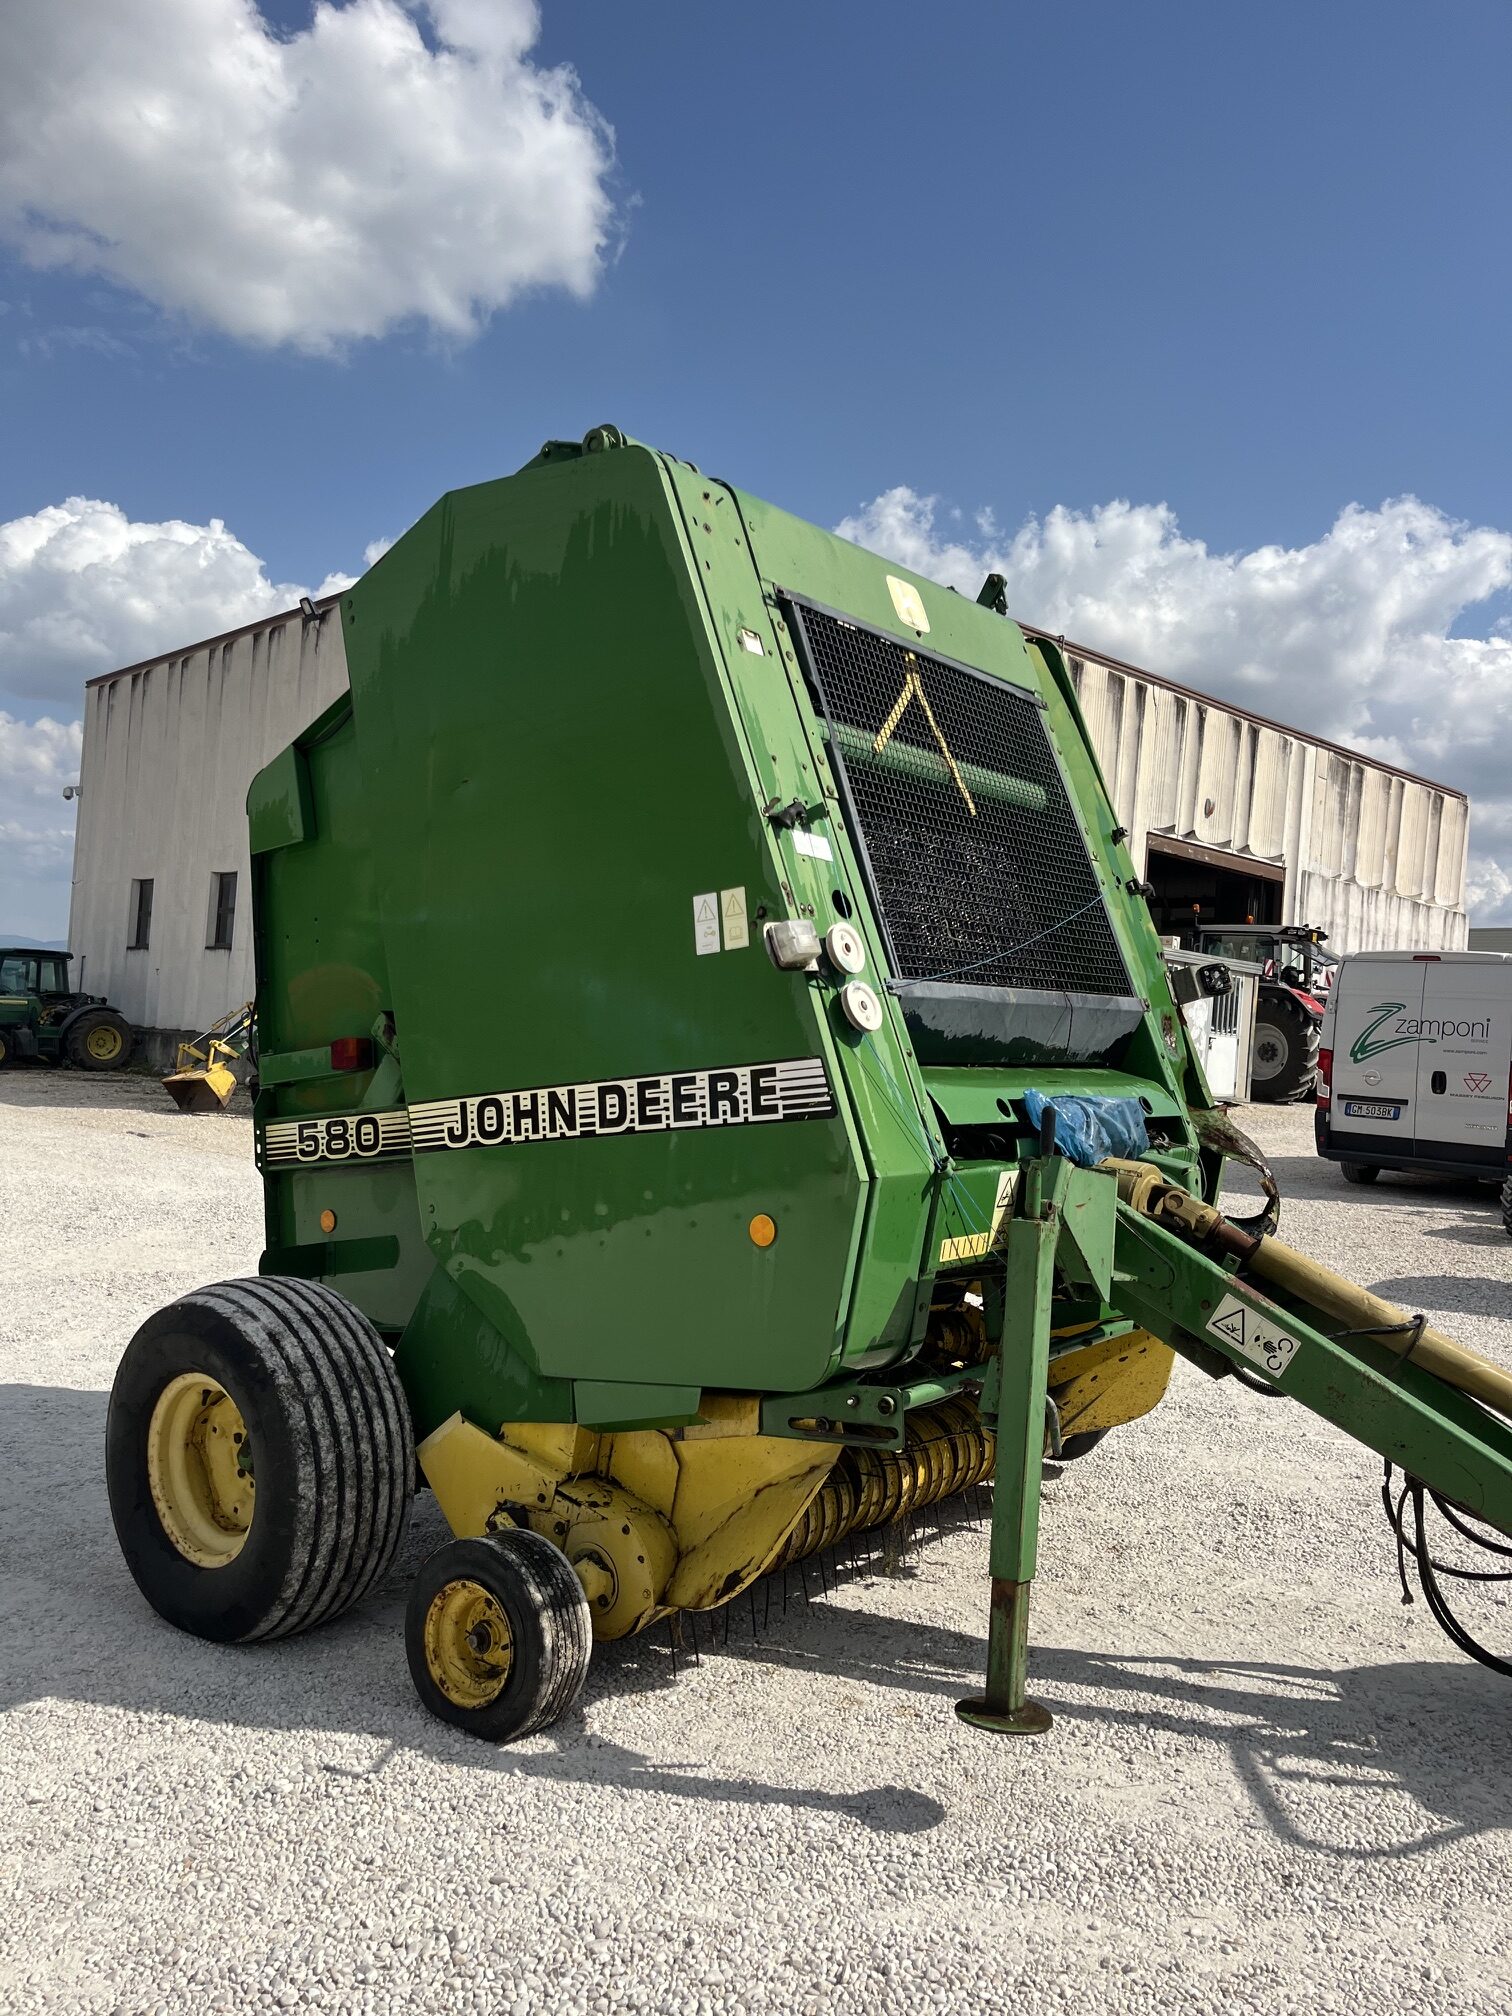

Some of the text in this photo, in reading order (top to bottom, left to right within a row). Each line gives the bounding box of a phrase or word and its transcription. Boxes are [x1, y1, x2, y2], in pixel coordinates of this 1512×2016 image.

[1395, 1018, 1491, 1040] zamponi
[445, 1066, 782, 1147] JOHN DEERE
[296, 1116, 382, 1161] 580
